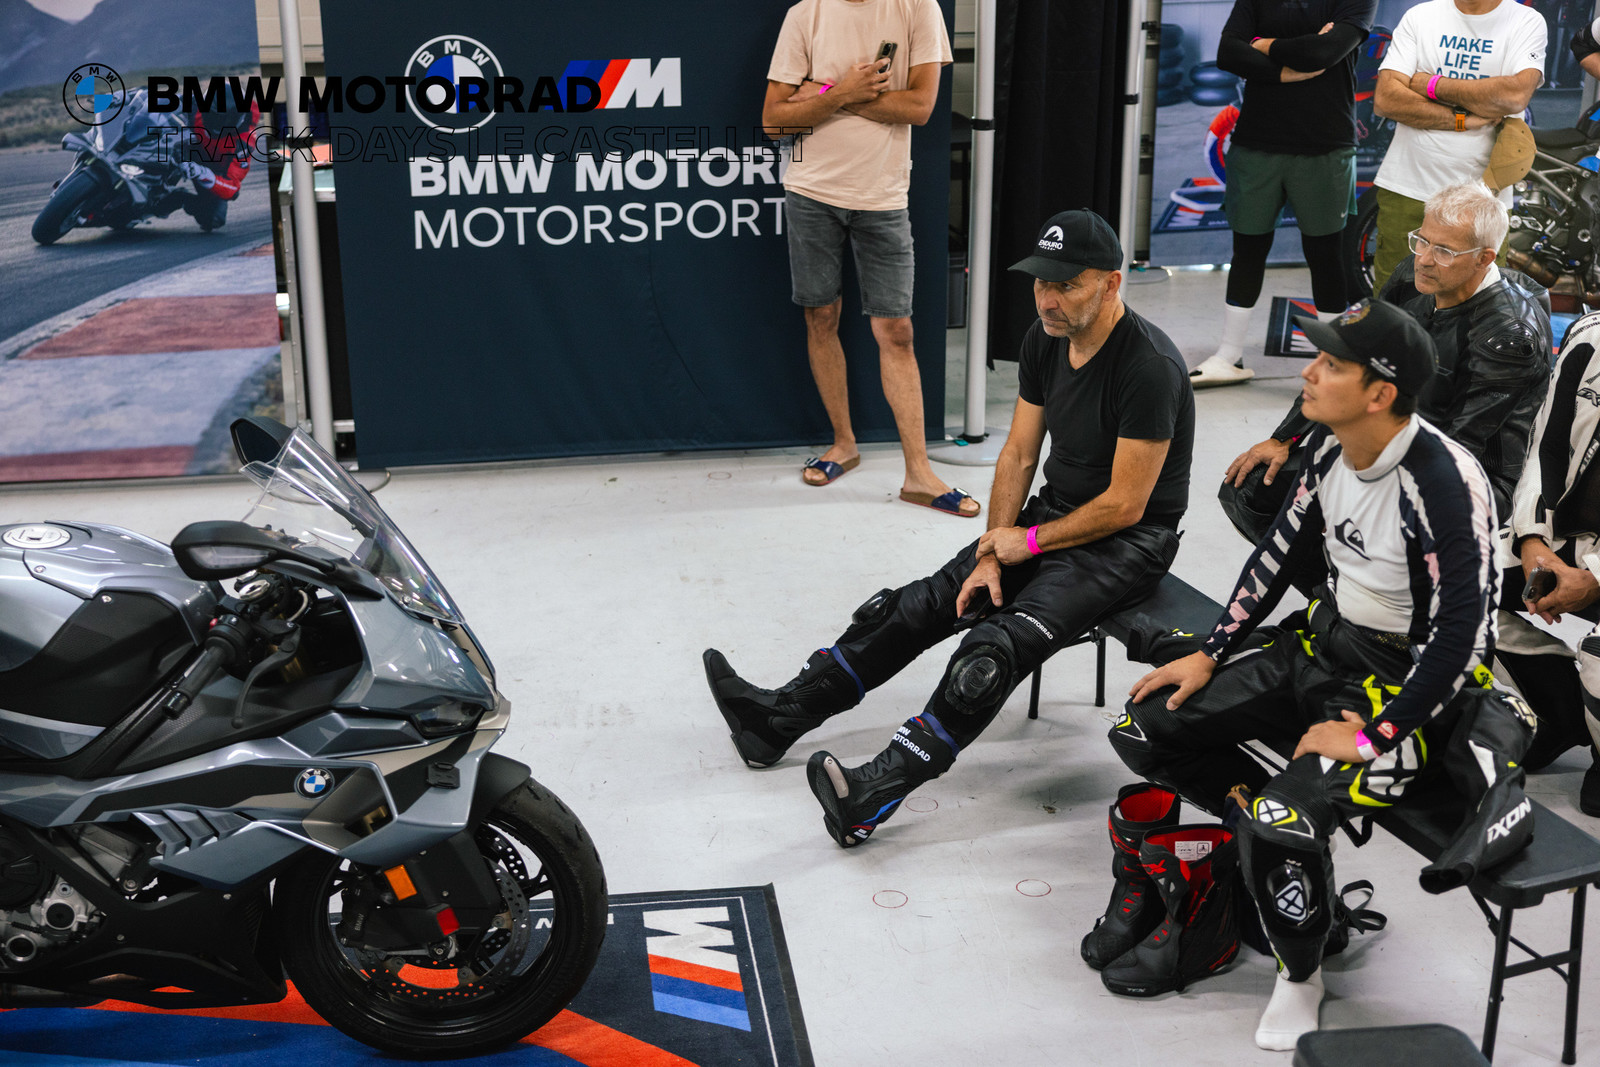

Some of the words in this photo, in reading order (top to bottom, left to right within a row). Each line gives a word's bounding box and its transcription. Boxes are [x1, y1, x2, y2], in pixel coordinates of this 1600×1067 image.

[1439, 34, 1494, 54] MAKE
[1444, 51, 1482, 71] LIFE
[408, 153, 556, 198] BMW
[413, 197, 786, 250] MOTORSPORT
[1038, 239, 1063, 250] ENDURO
[1025, 615, 1054, 640] MOTORRAD
[892, 733, 931, 762] OTORRAD
